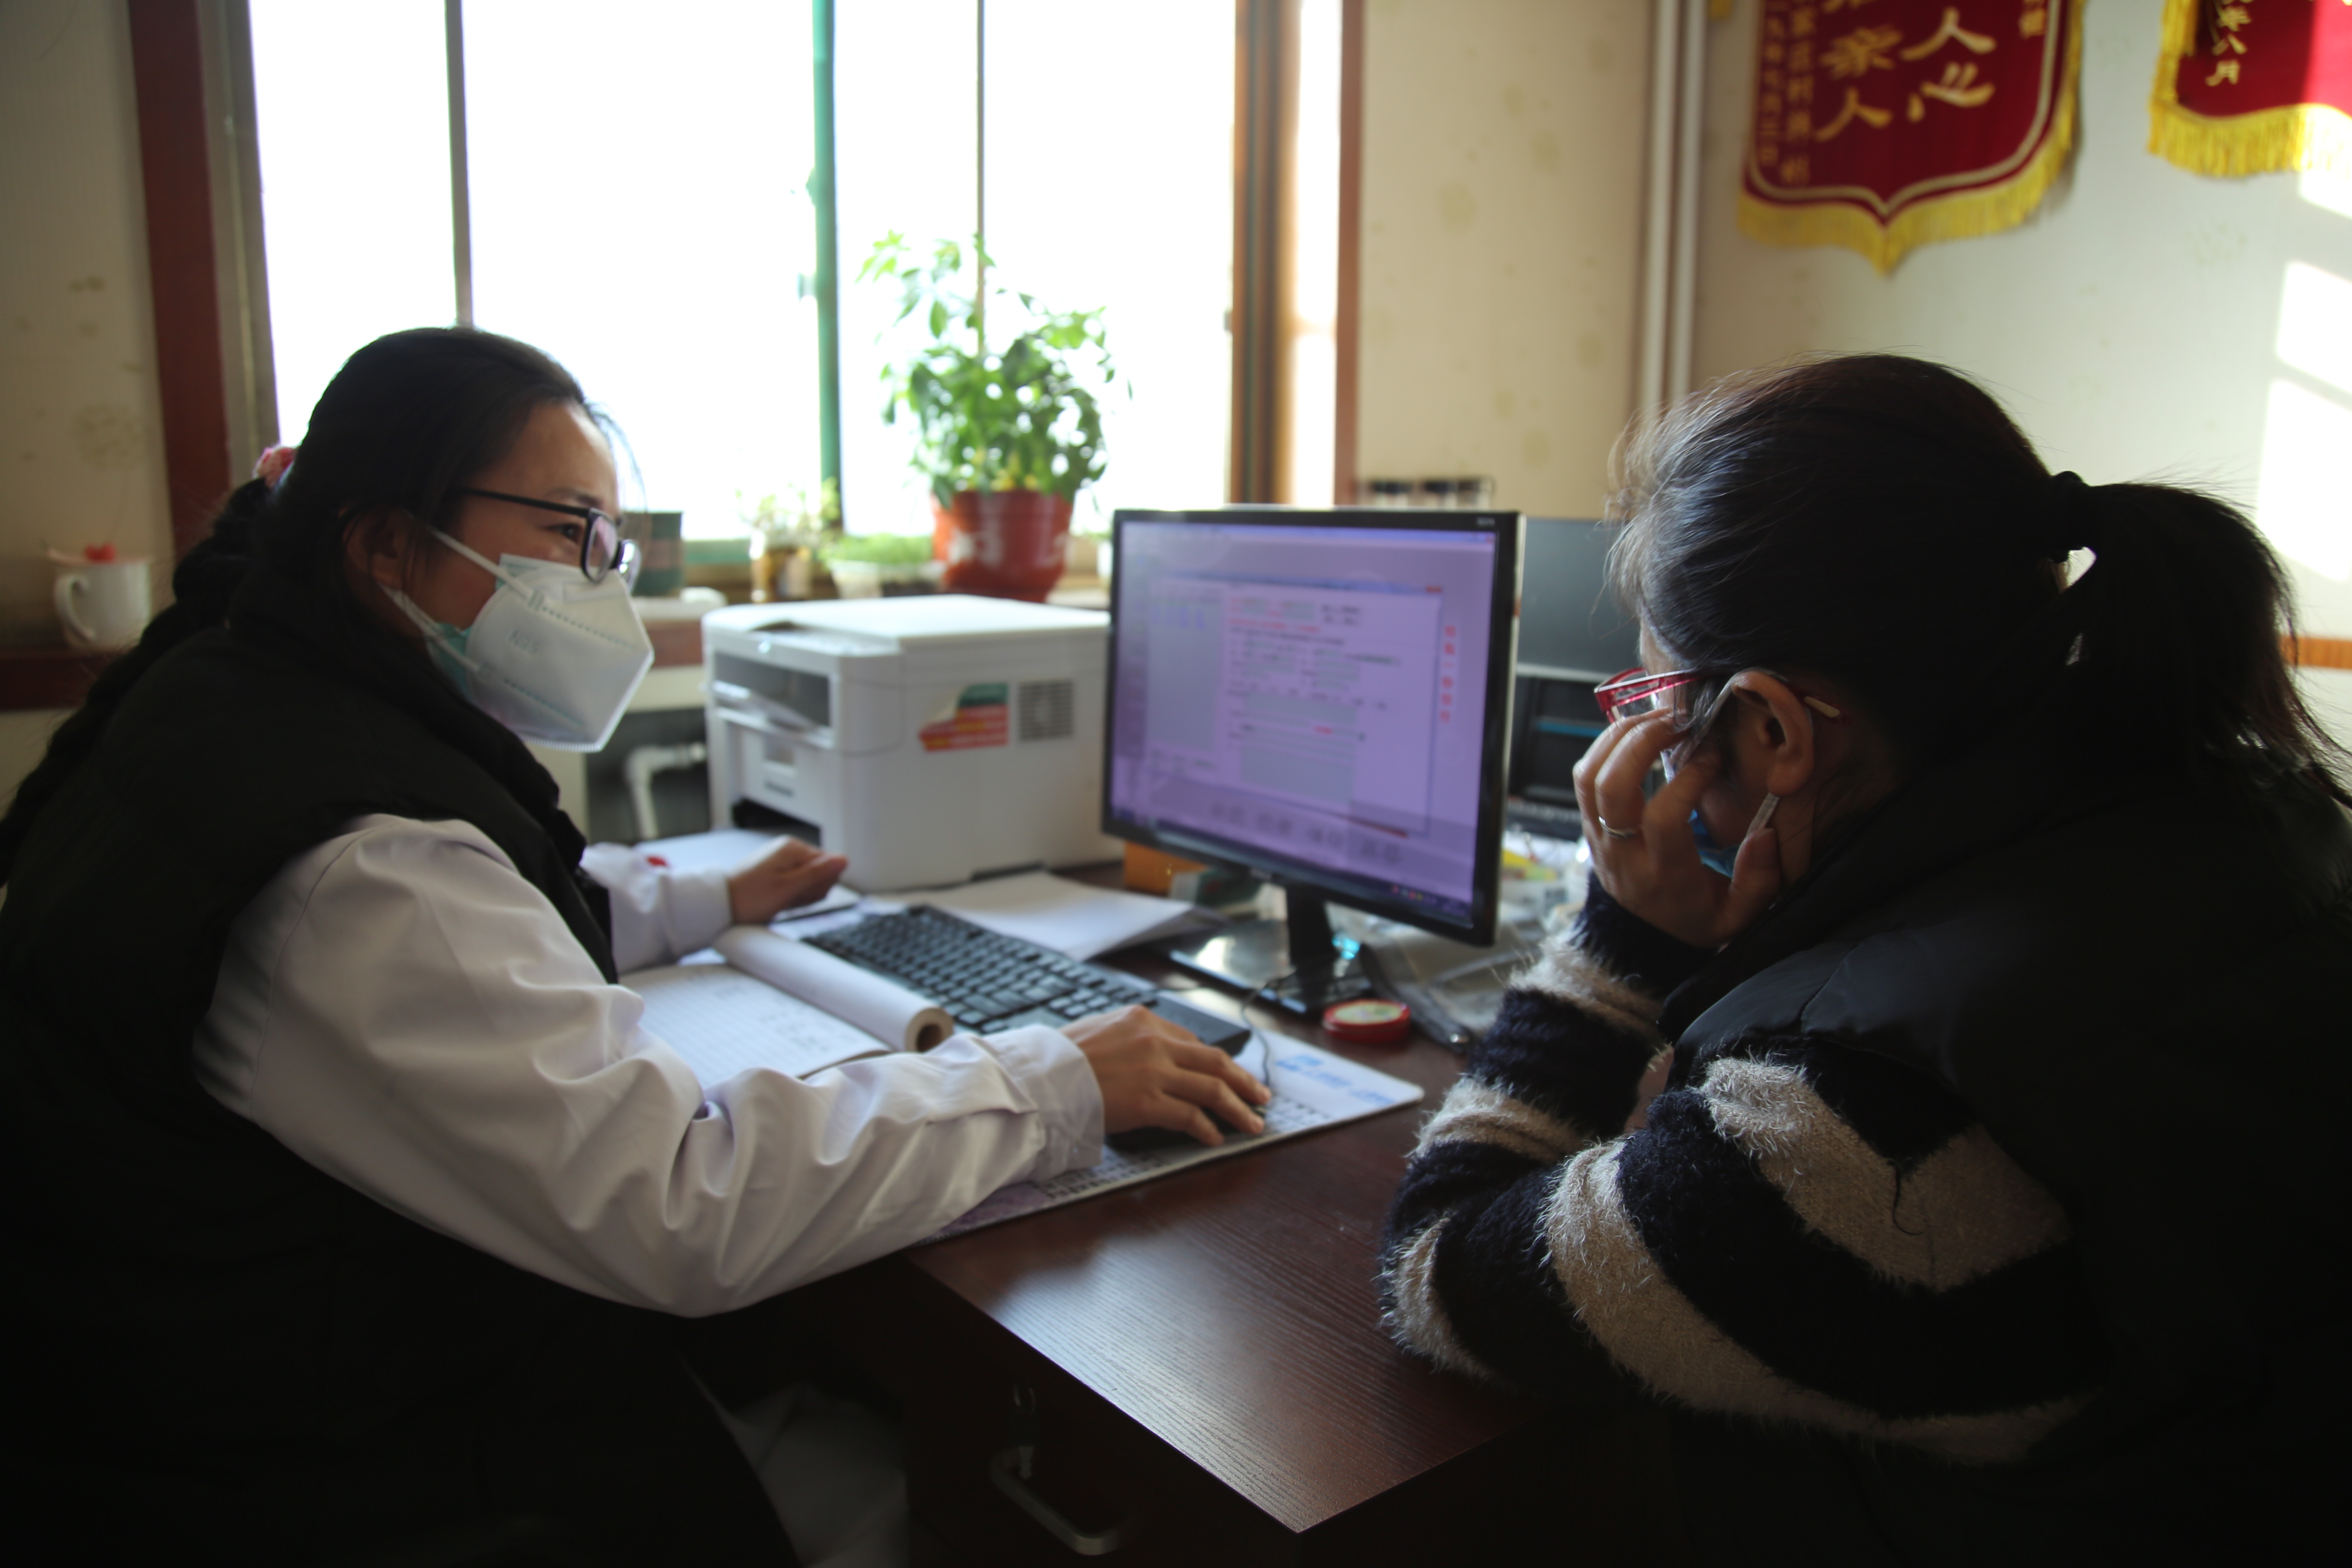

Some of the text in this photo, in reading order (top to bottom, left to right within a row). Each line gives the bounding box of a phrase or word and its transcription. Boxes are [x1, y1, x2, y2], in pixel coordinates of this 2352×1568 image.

[1815, 0, 1902, 142] 亲人
[1897, 7, 1997, 123] 人心
[2205, 0, 2252, 86] 年八月
